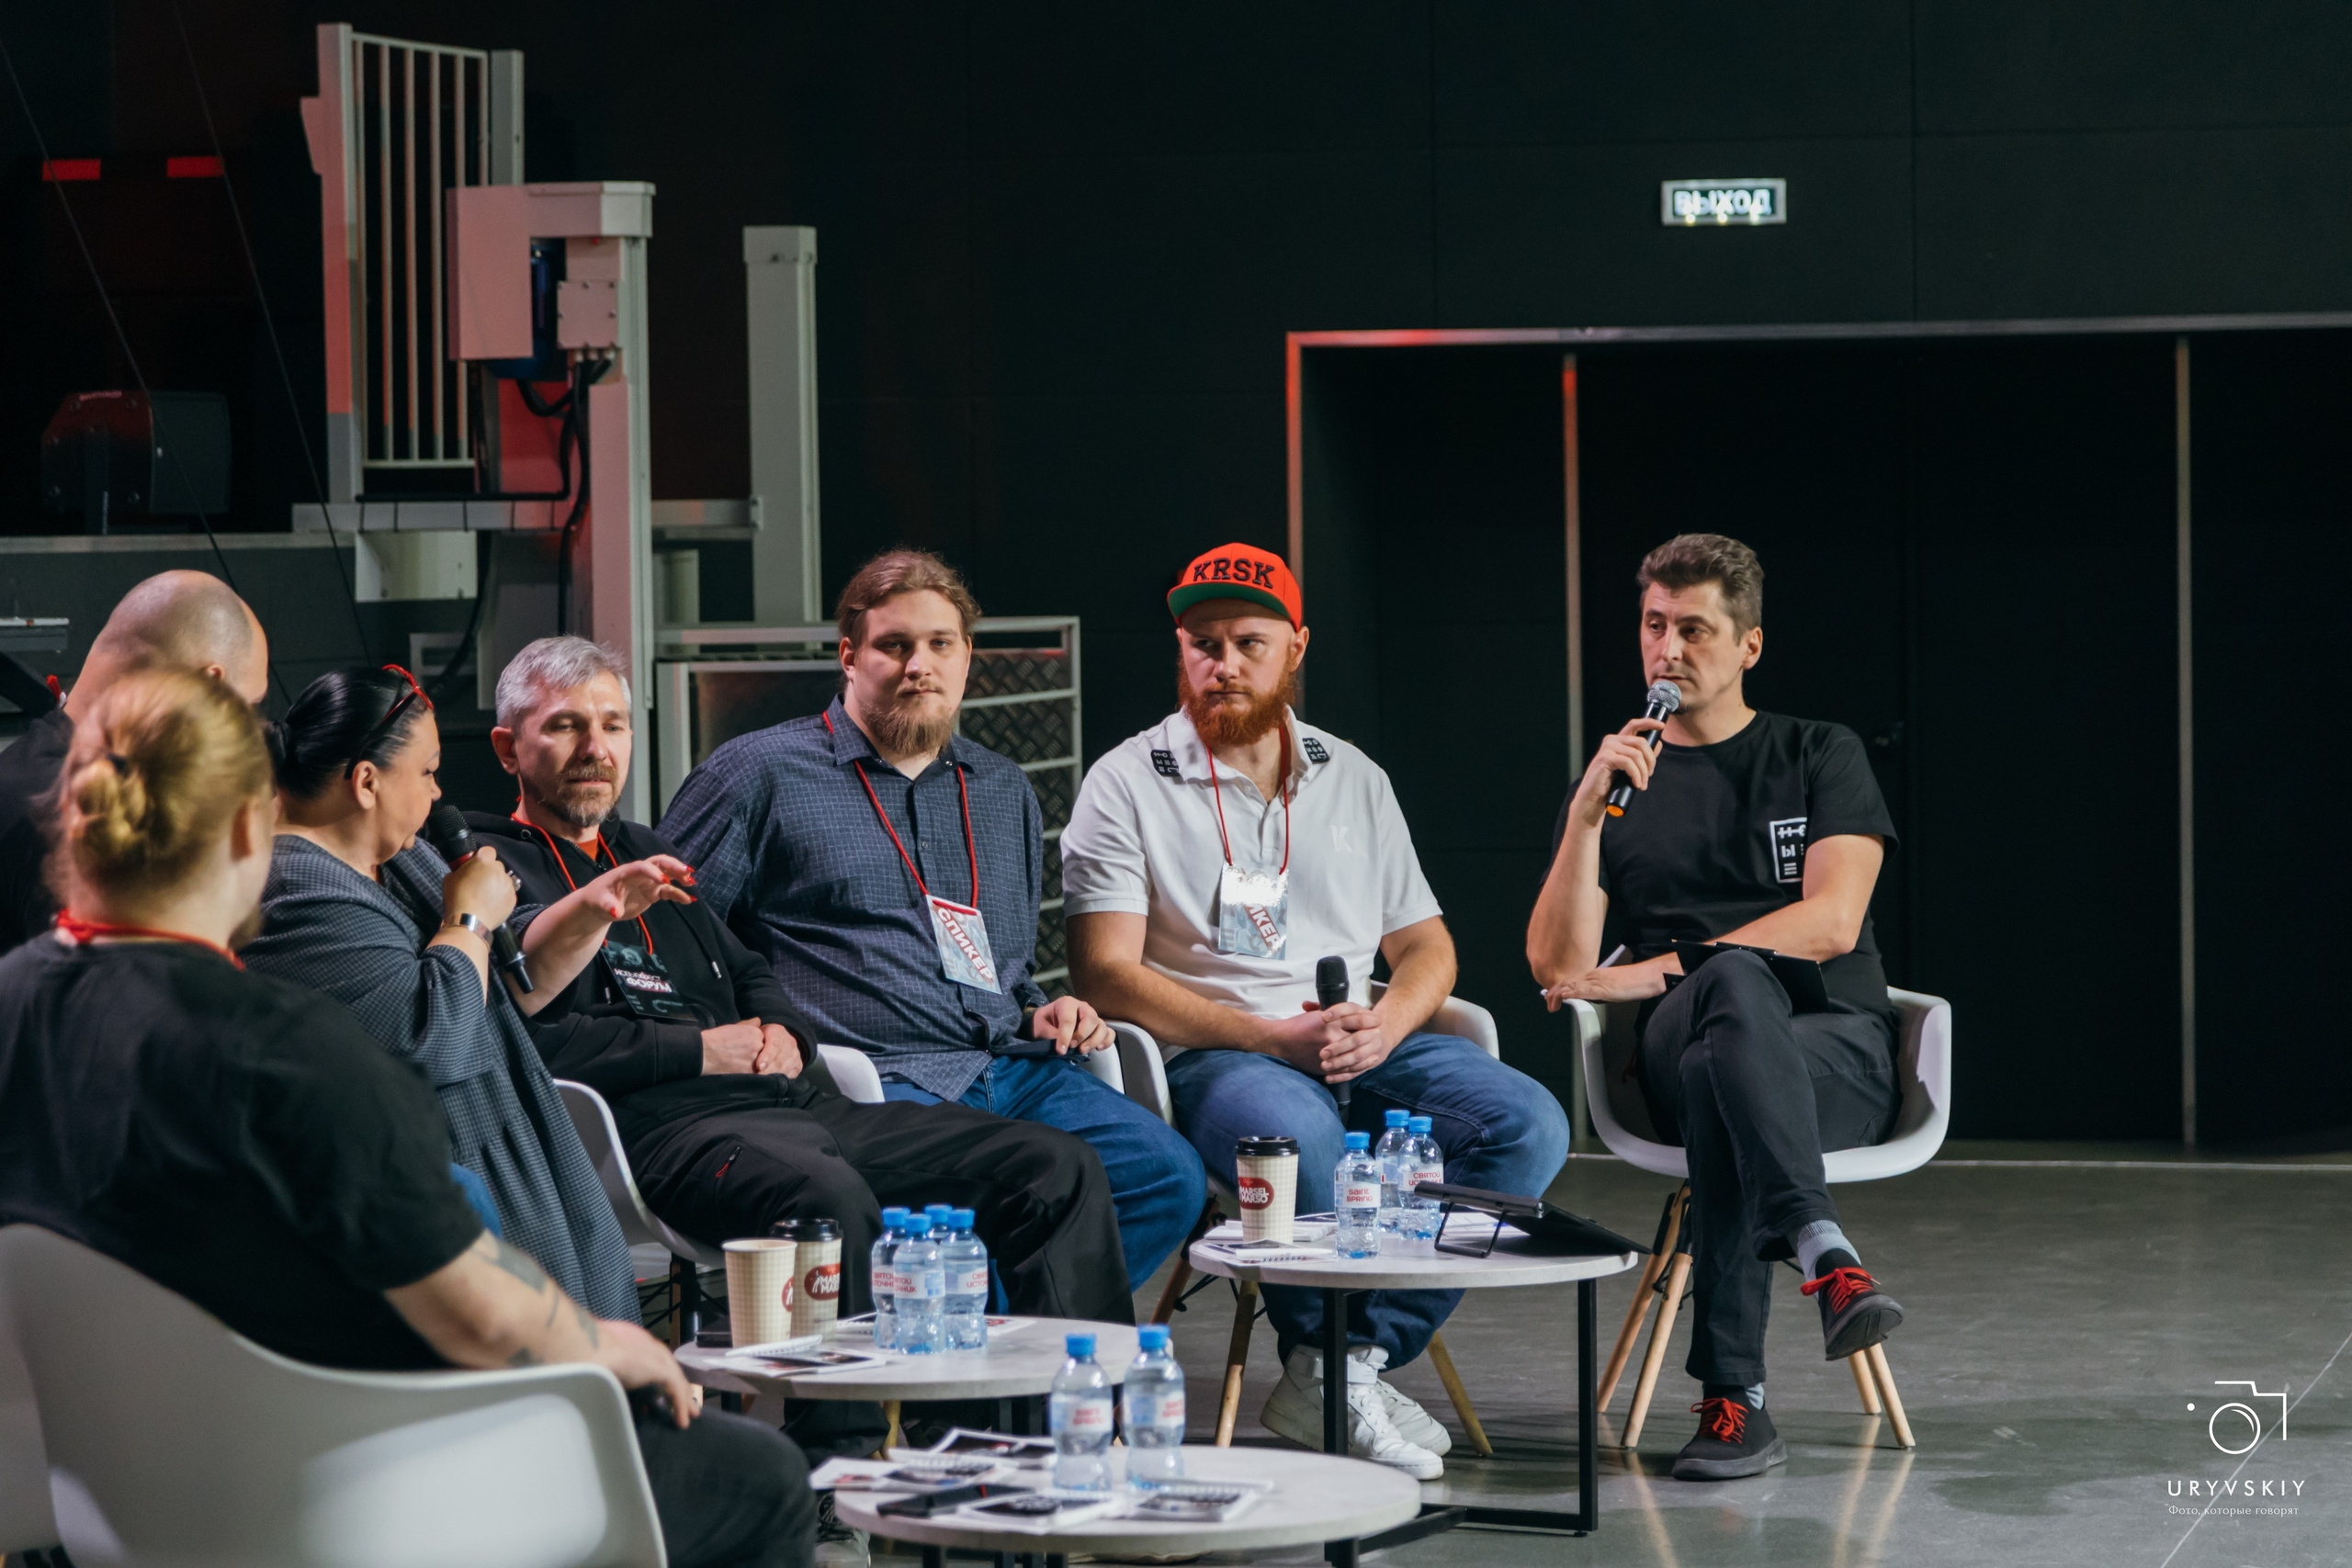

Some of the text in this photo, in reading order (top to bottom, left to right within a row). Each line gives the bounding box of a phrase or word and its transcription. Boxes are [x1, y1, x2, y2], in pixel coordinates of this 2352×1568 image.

[1674, 189, 1771, 216] ВЫХОД
[1193, 558, 1275, 590] KRSK
[937, 907, 994, 980] СПИКЕР
[626, 977, 673, 993] ФОРУМ
